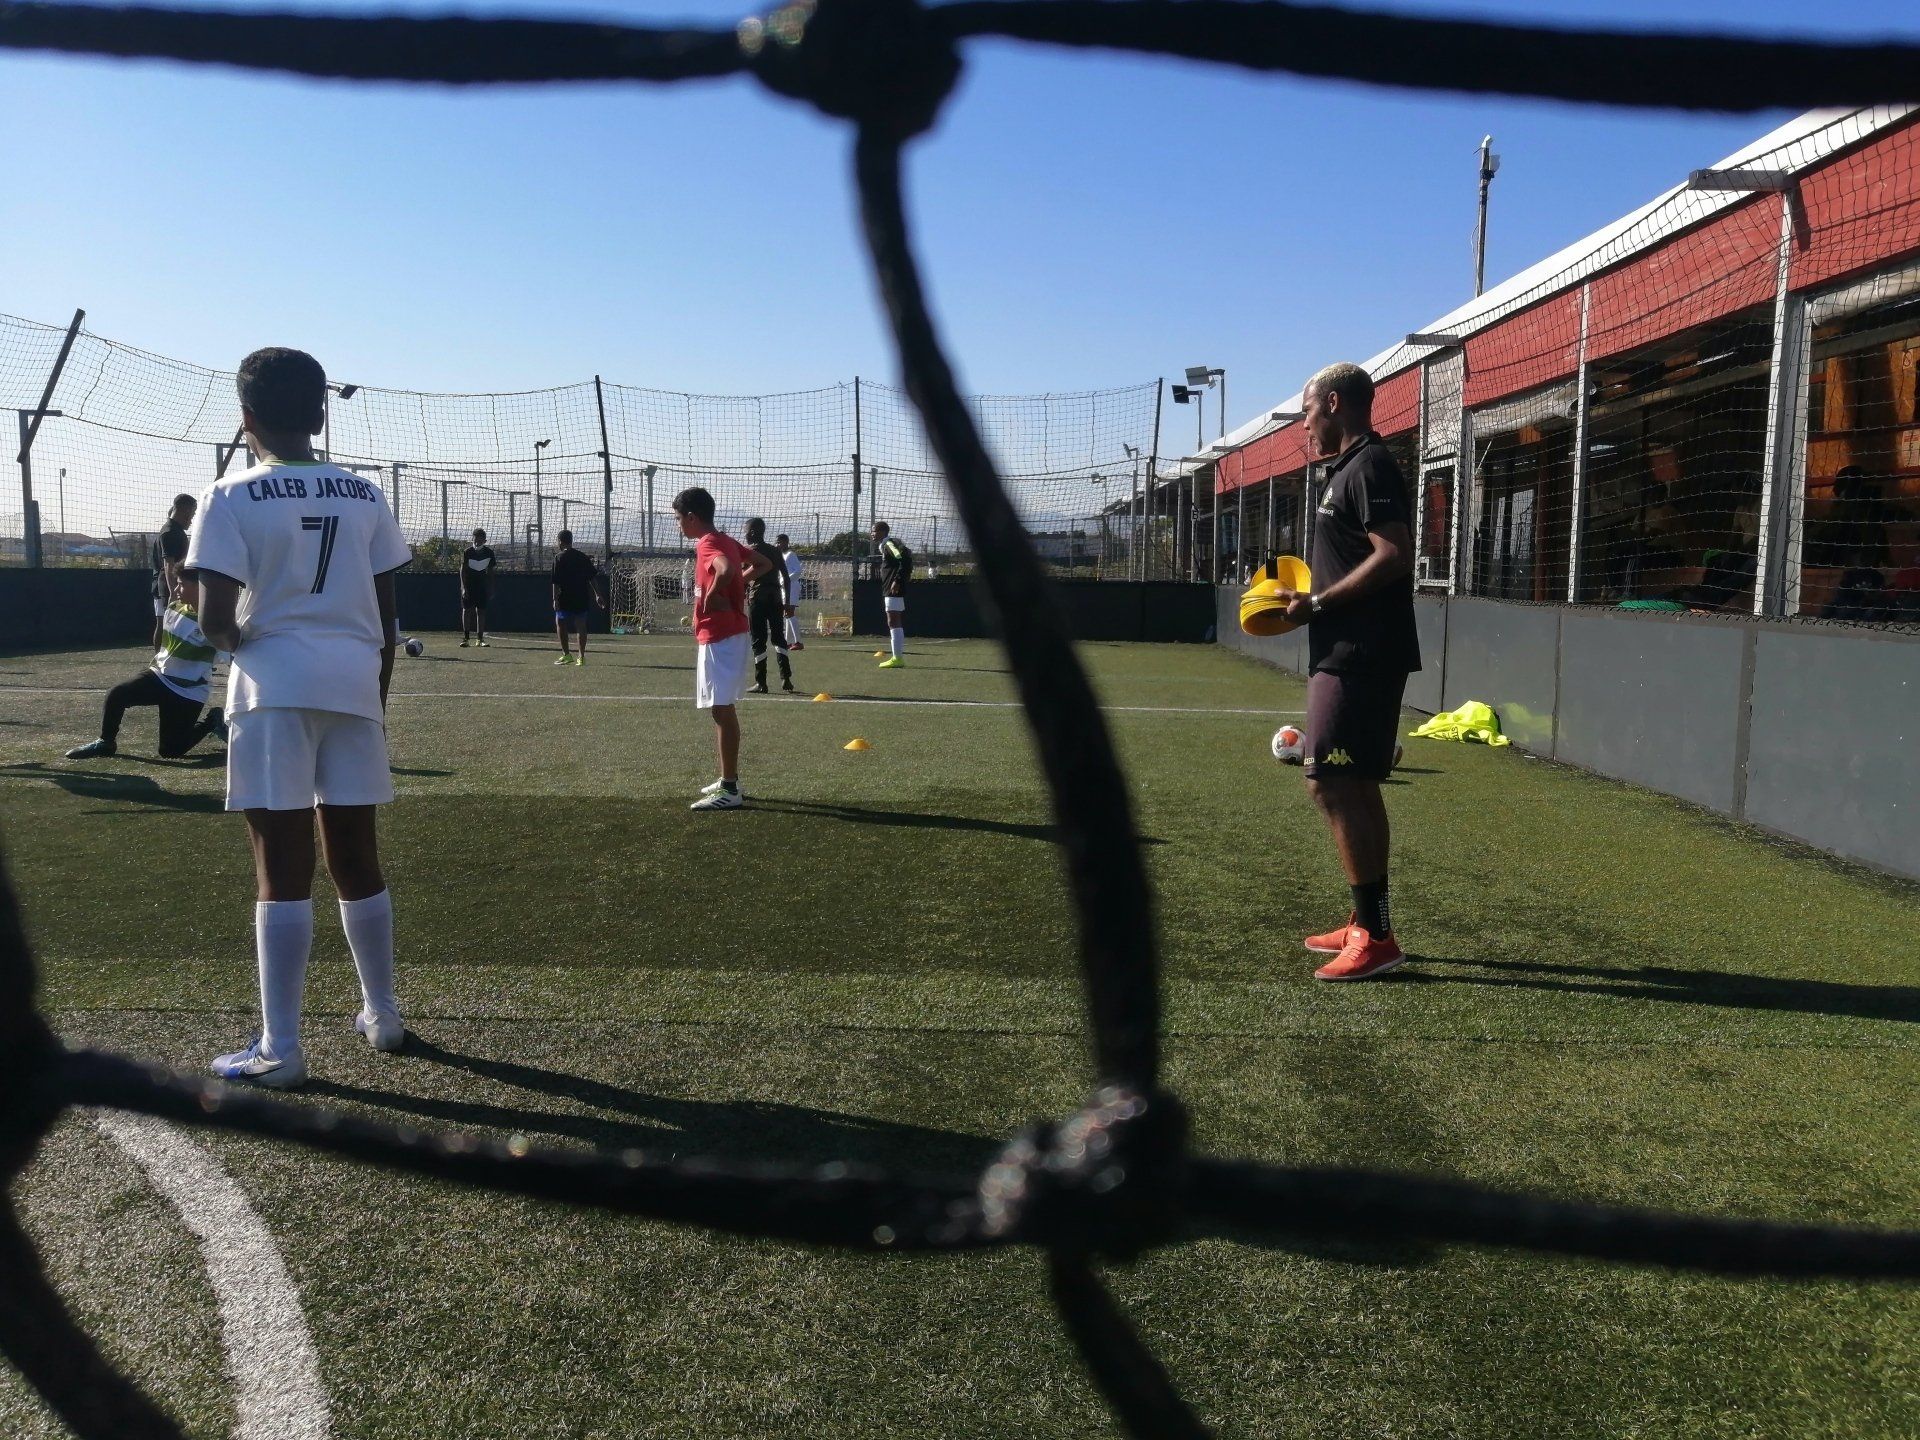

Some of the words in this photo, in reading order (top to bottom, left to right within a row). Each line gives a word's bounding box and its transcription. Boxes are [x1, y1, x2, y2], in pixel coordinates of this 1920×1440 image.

[247, 478, 307, 501] CALEB
[315, 477, 376, 503] JACOBS
[301, 516, 339, 594] 7
